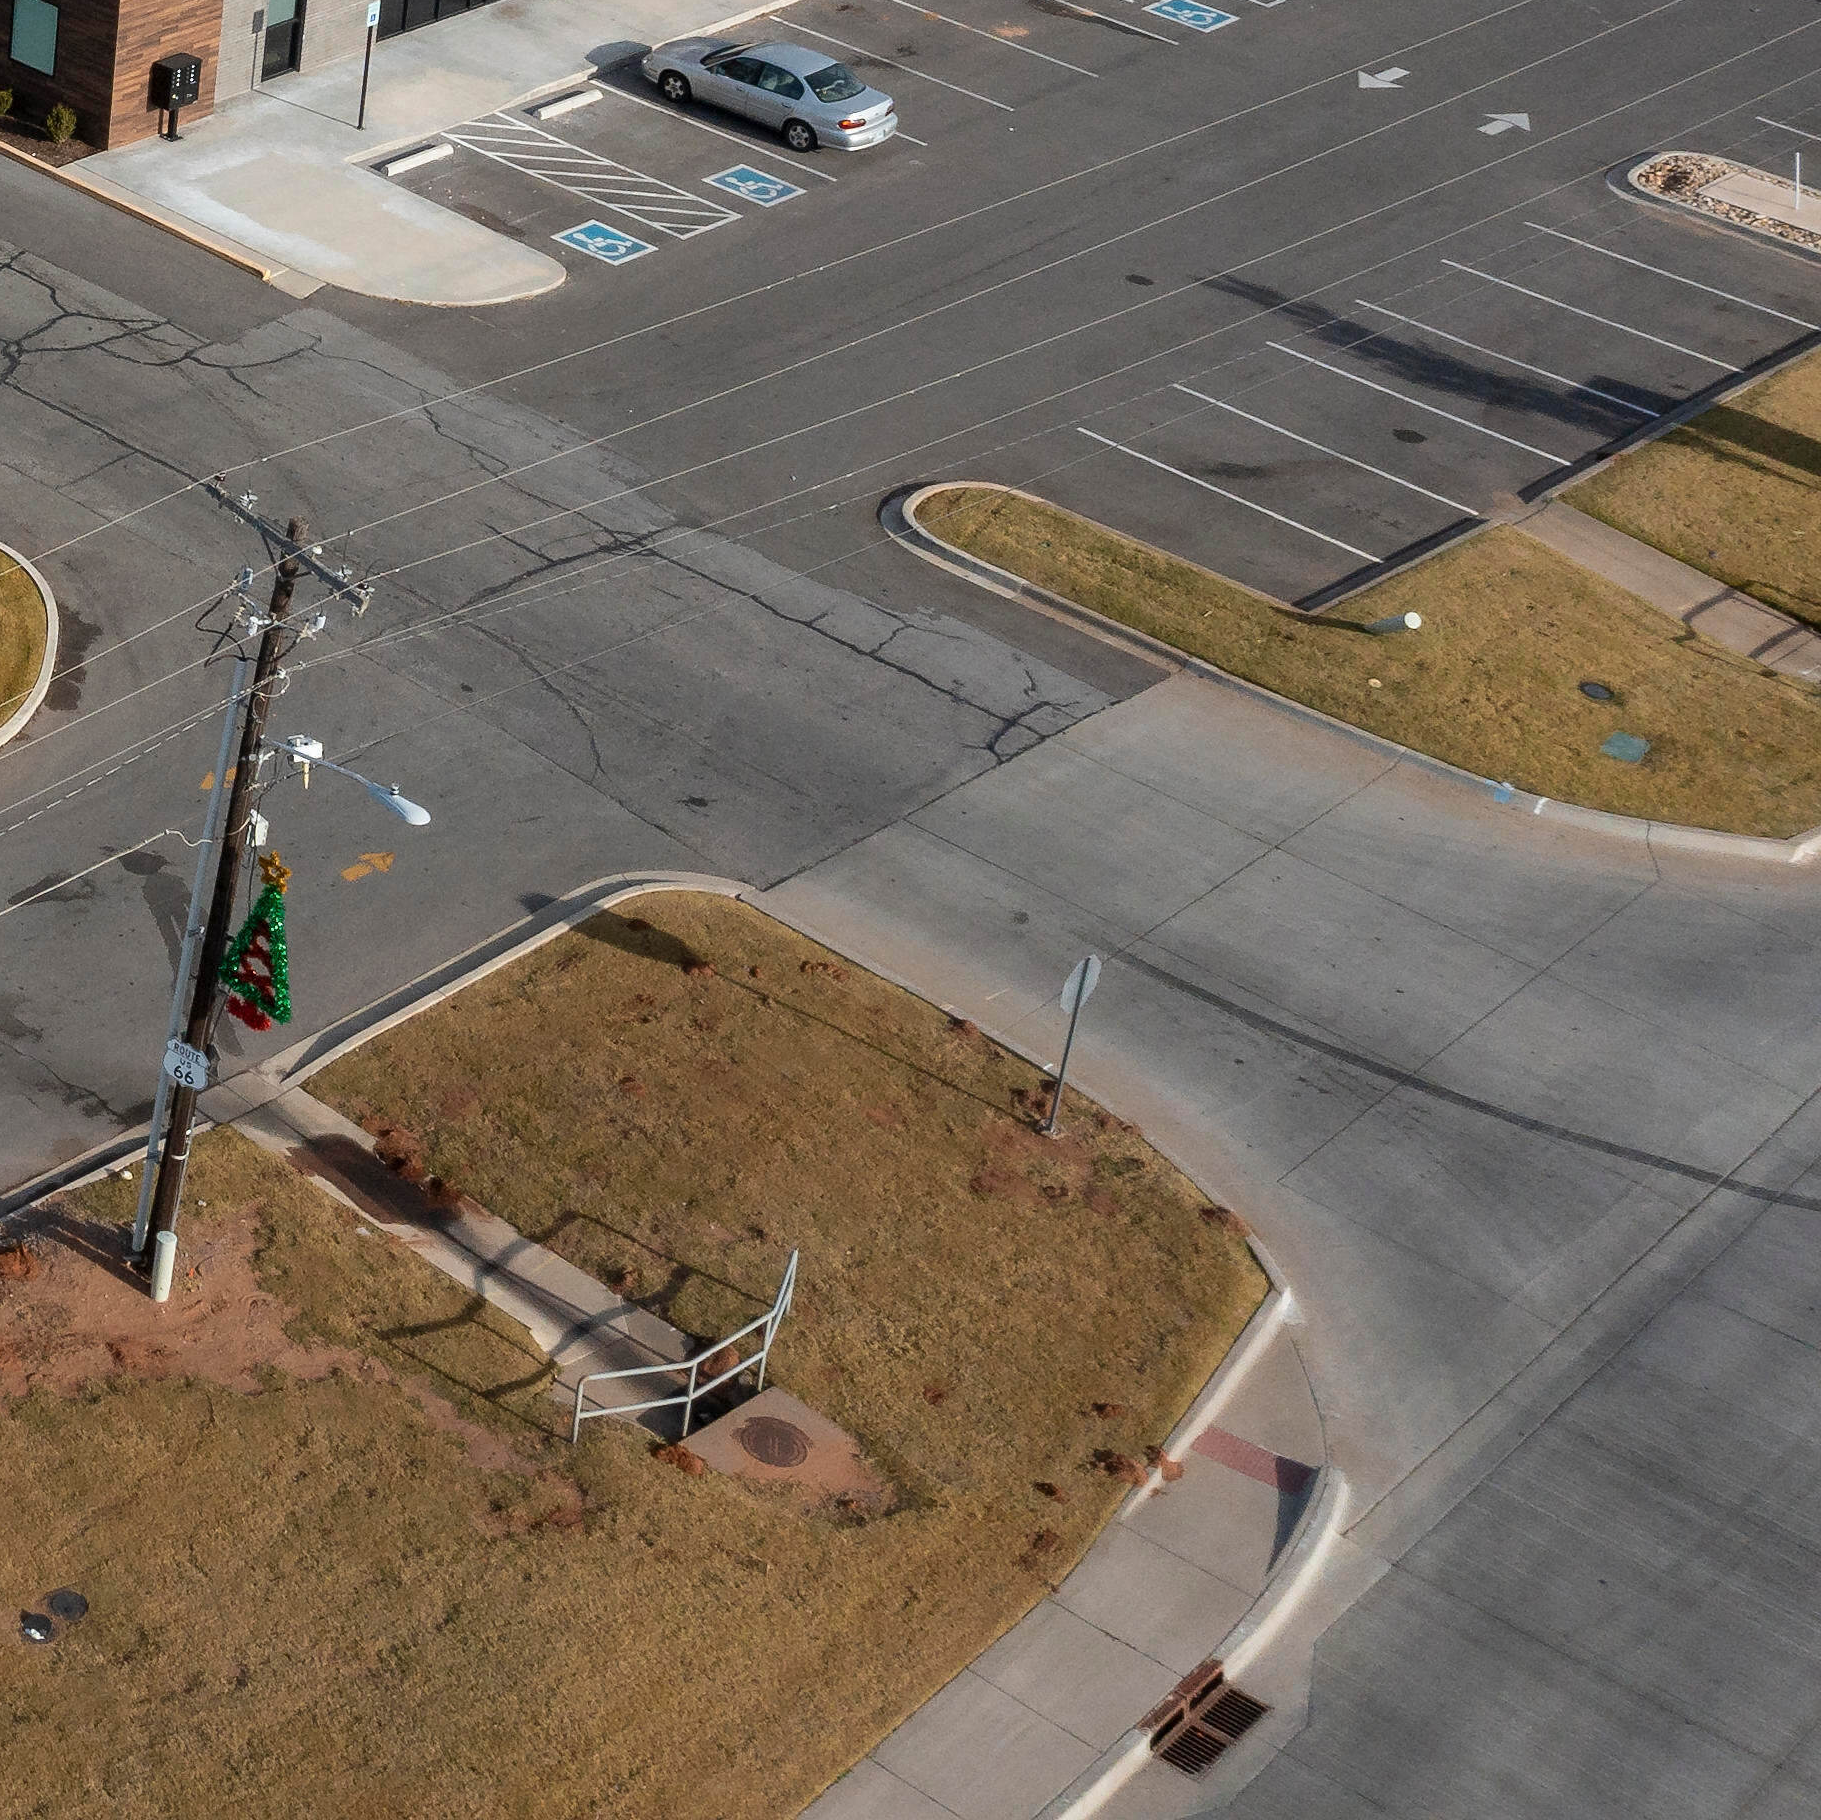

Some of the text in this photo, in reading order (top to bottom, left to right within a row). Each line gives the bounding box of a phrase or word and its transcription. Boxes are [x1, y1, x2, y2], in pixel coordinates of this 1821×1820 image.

[174, 1043, 201, 1062] ROUTE
[179, 1058, 192, 1069] US
[173, 1065, 195, 1085] 66
